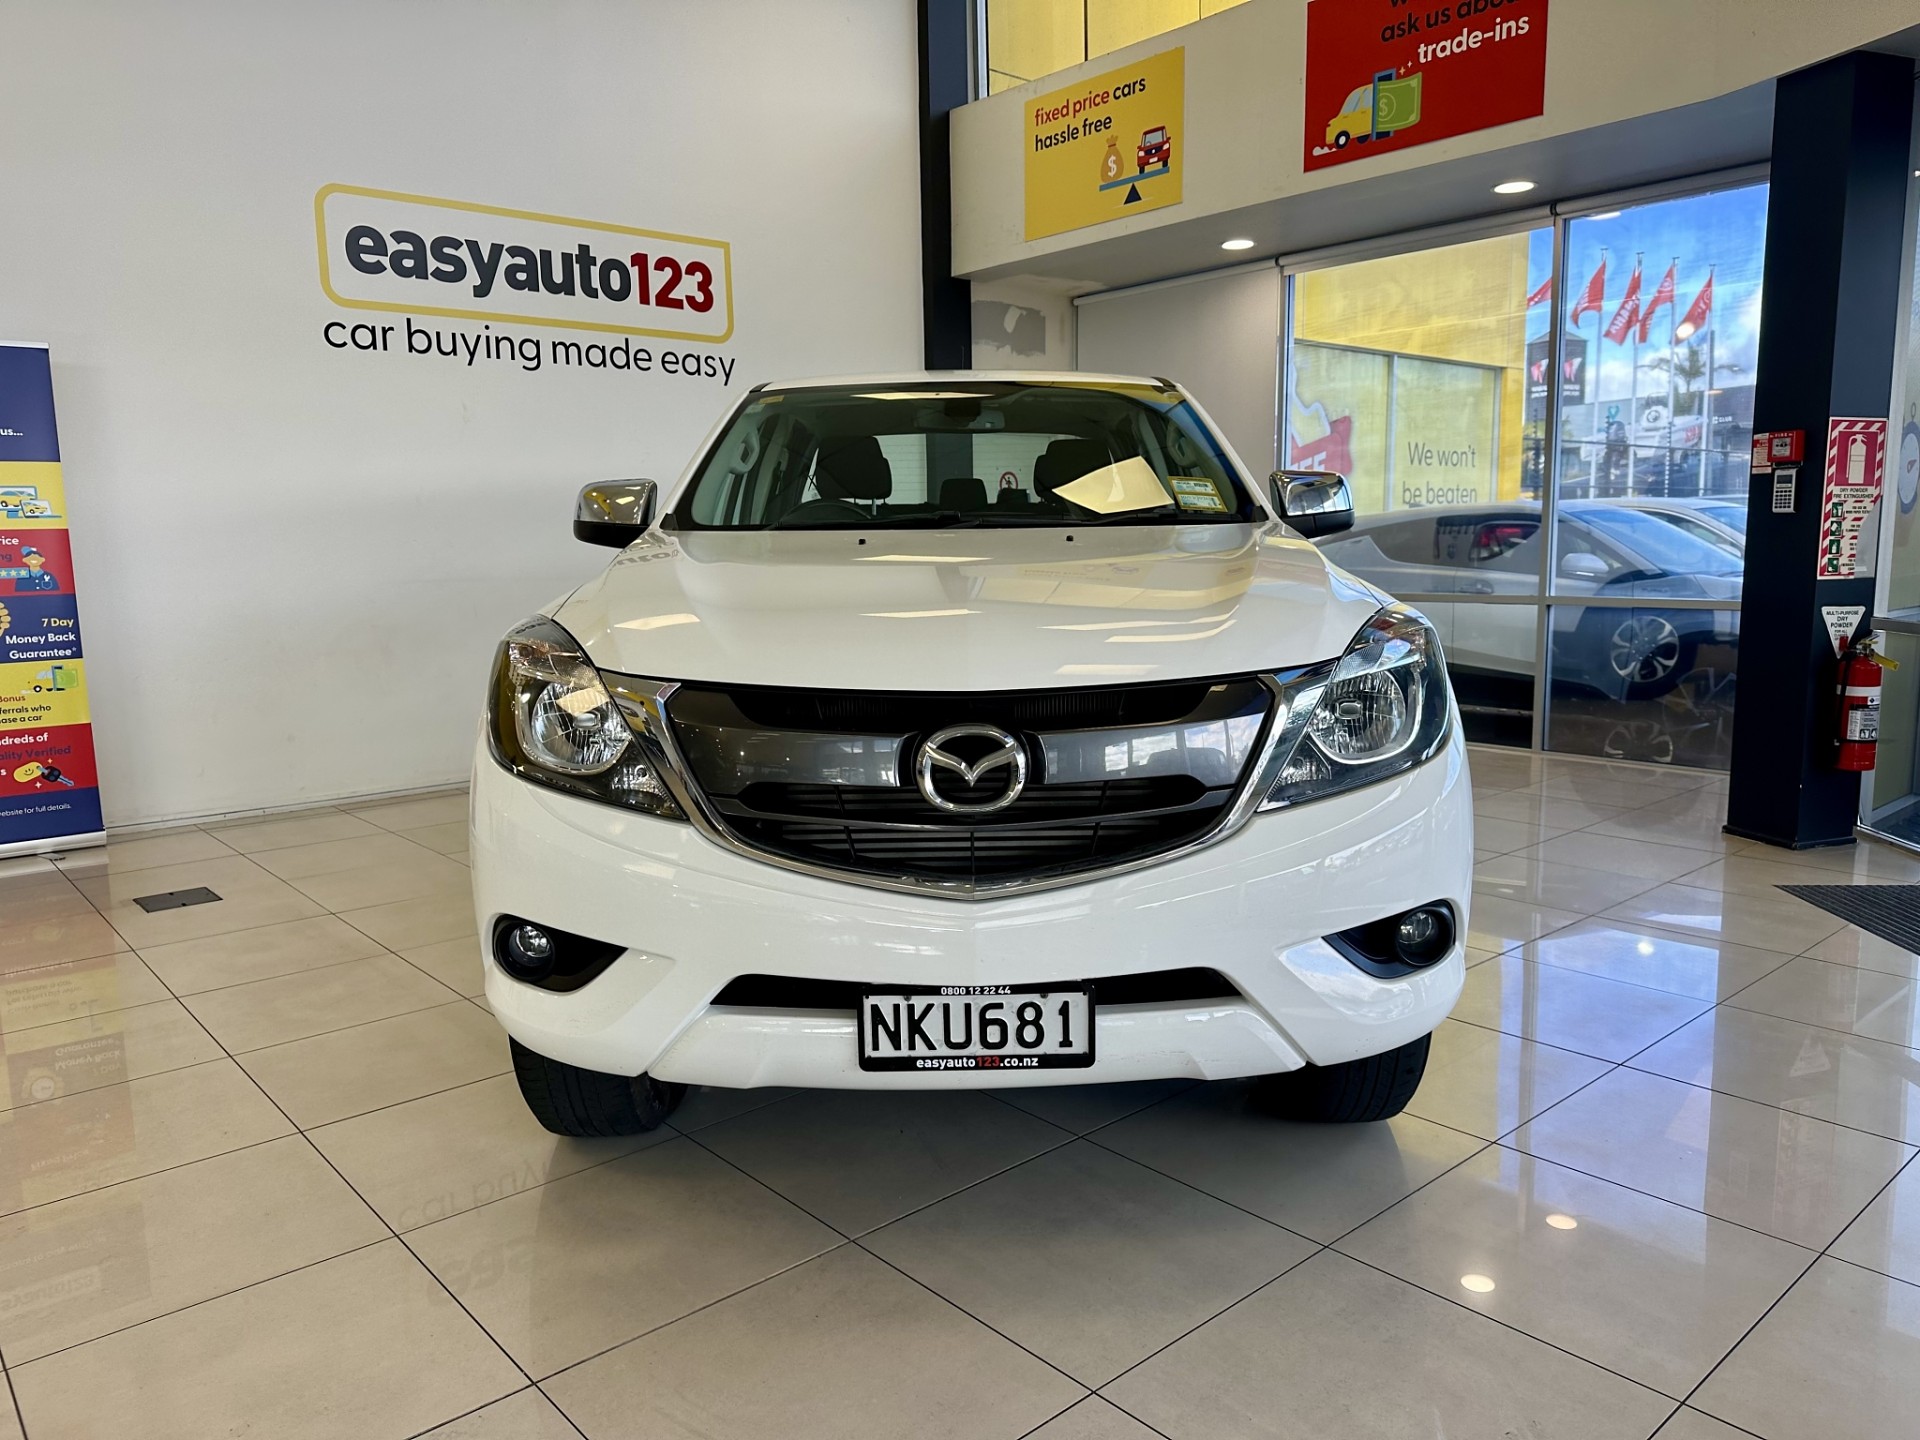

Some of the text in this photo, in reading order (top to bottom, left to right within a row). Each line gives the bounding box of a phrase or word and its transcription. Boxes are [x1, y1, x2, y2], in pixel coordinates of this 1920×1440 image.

[1381, 12, 1420, 42] ask
[1425, 7, 1451, 28] us
[1418, 16, 1530, 64] trade-ins
[1035, 78, 1146, 126] fixed price cars
[1035, 116, 1112, 152] hassle free
[344, 224, 715, 313] easyauto123
[323, 317, 735, 386] car buying made easy
[1407, 442, 1476, 468] We won't
[1402, 481, 1477, 504] be beaten
[0, 536, 19, 545] ice
[42, 618, 74, 628] 7 Day
[5, 632, 76, 644] Money Back
[0, 704, 51, 714] ferrals who
[36, 732, 48, 742] of
[0, 746, 71, 760] ality Verified
[941, 986, 1011, 995] 0800 12 22 44
[870, 1000, 1073, 1051] NKU681
[916, 1056, 1038, 1070] easyauto123.co.nz
